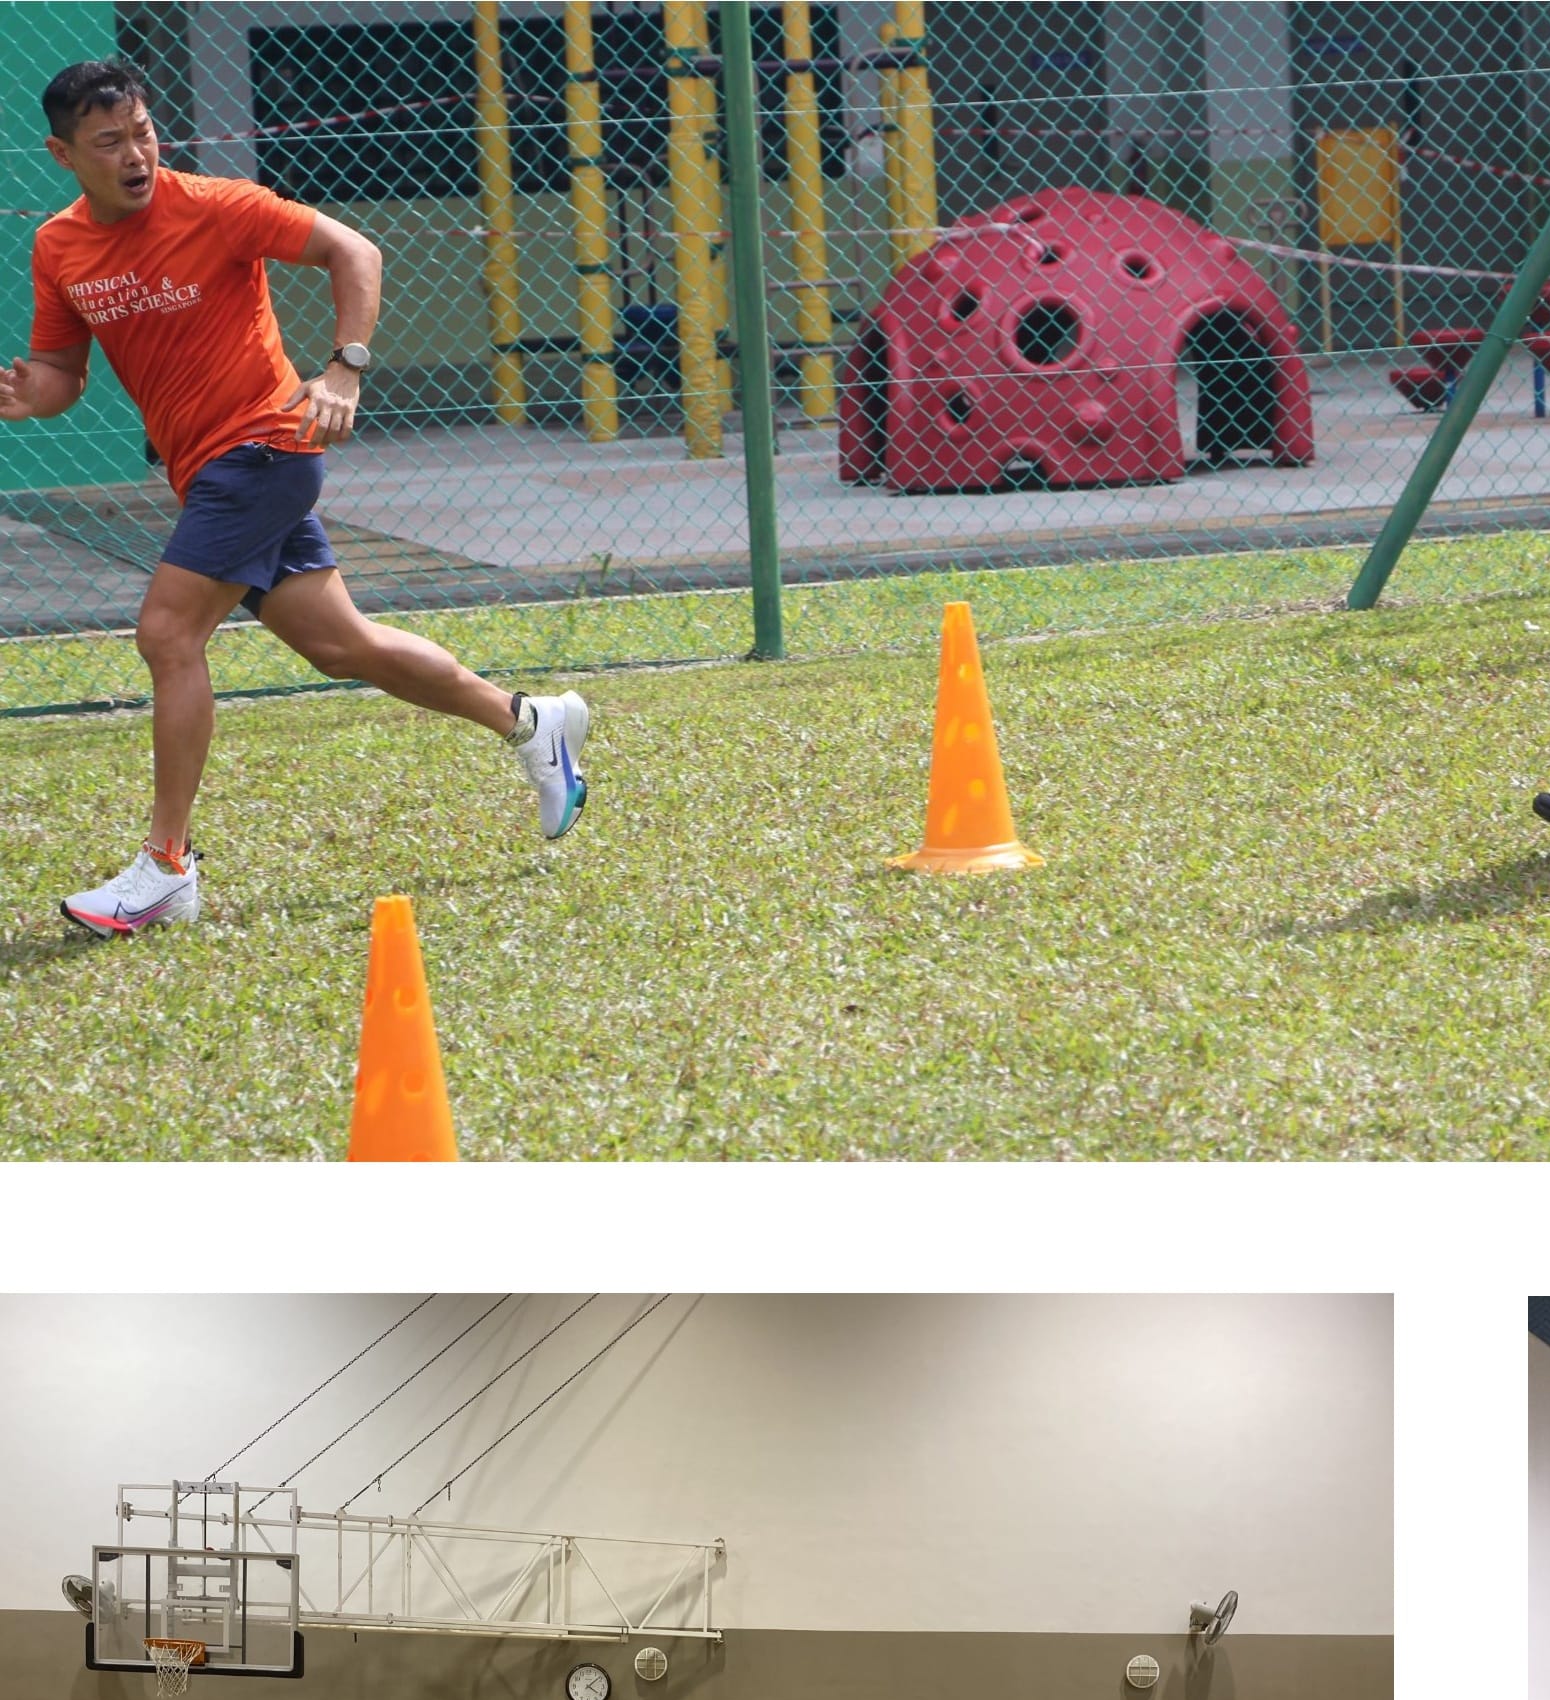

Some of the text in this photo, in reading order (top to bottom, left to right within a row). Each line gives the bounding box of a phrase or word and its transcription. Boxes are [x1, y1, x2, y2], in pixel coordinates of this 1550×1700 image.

[67, 271, 141, 299] PHYSICAL
[161, 276, 172, 290] &
[130, 283, 201, 313] SCIENCE
